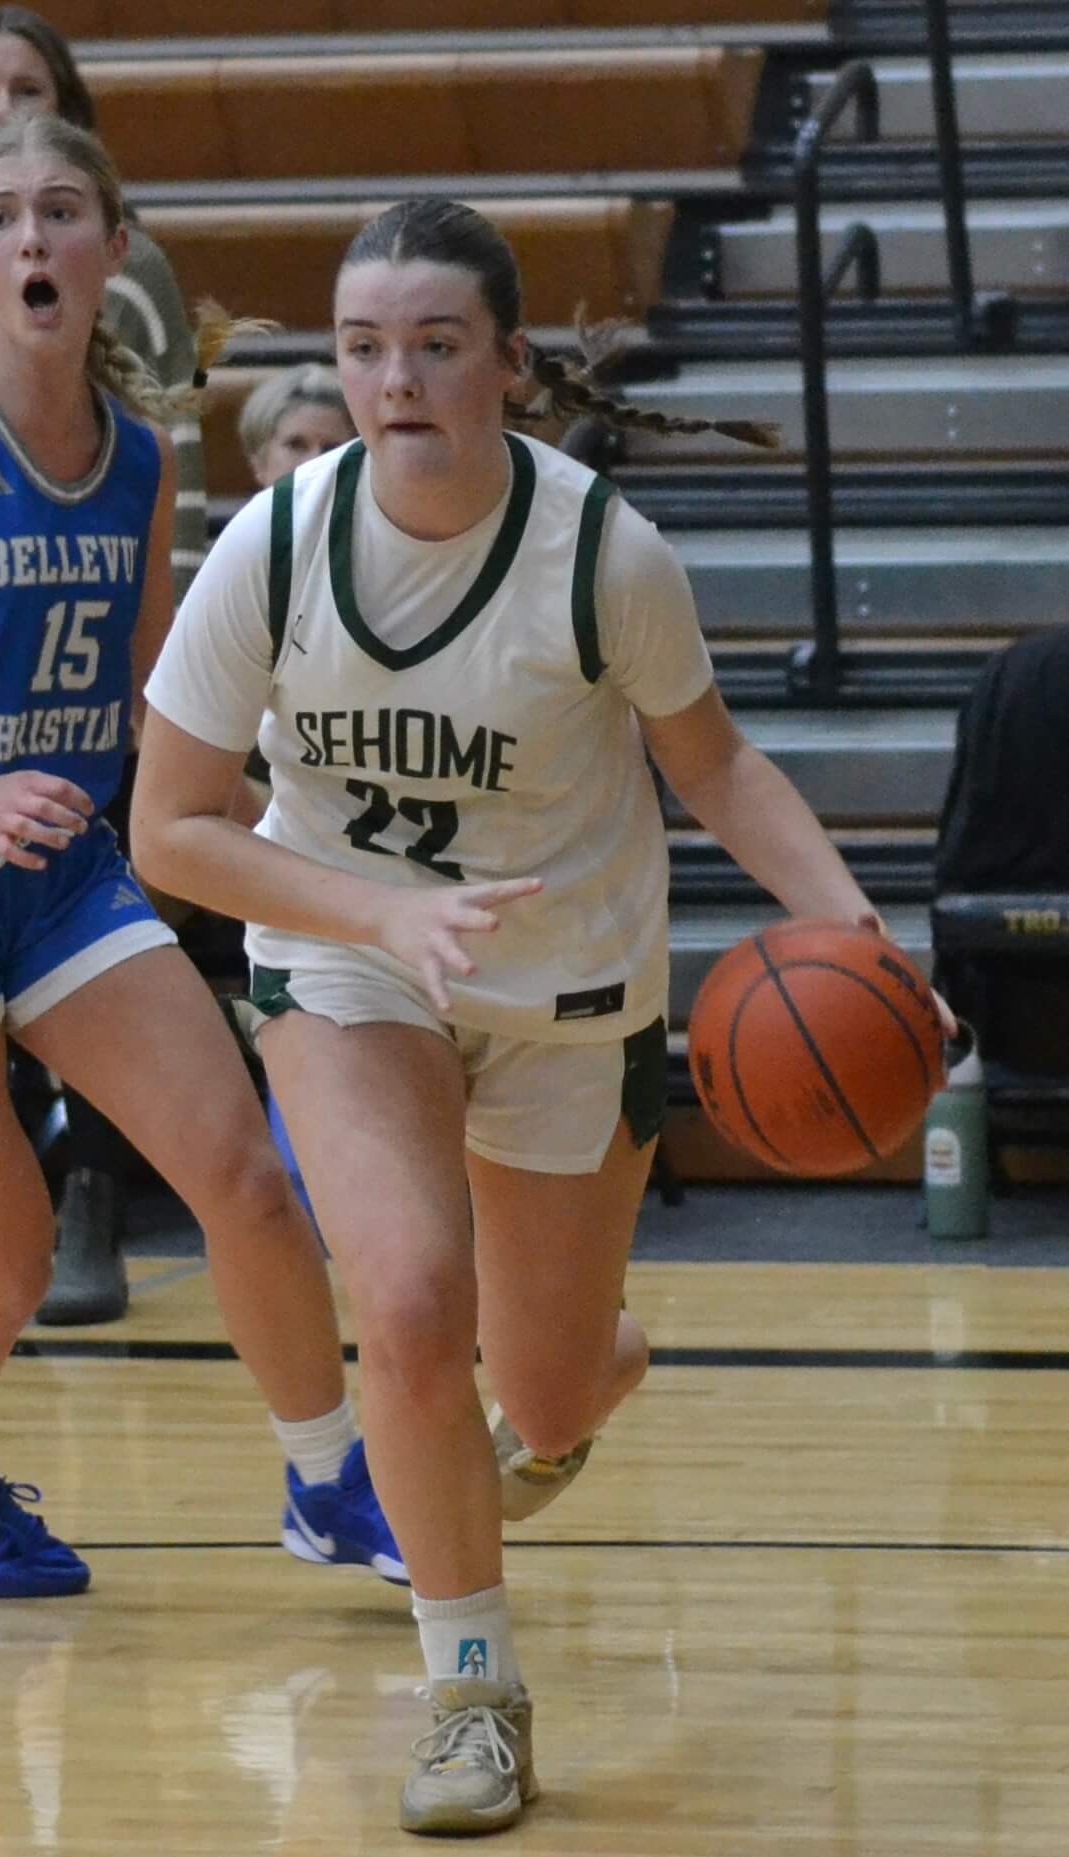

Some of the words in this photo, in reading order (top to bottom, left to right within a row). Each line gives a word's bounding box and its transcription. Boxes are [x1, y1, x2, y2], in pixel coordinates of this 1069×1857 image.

[31, 600, 111, 693] 15
[295, 707, 518, 793] SEHOME
[341, 777, 466, 882] 22
